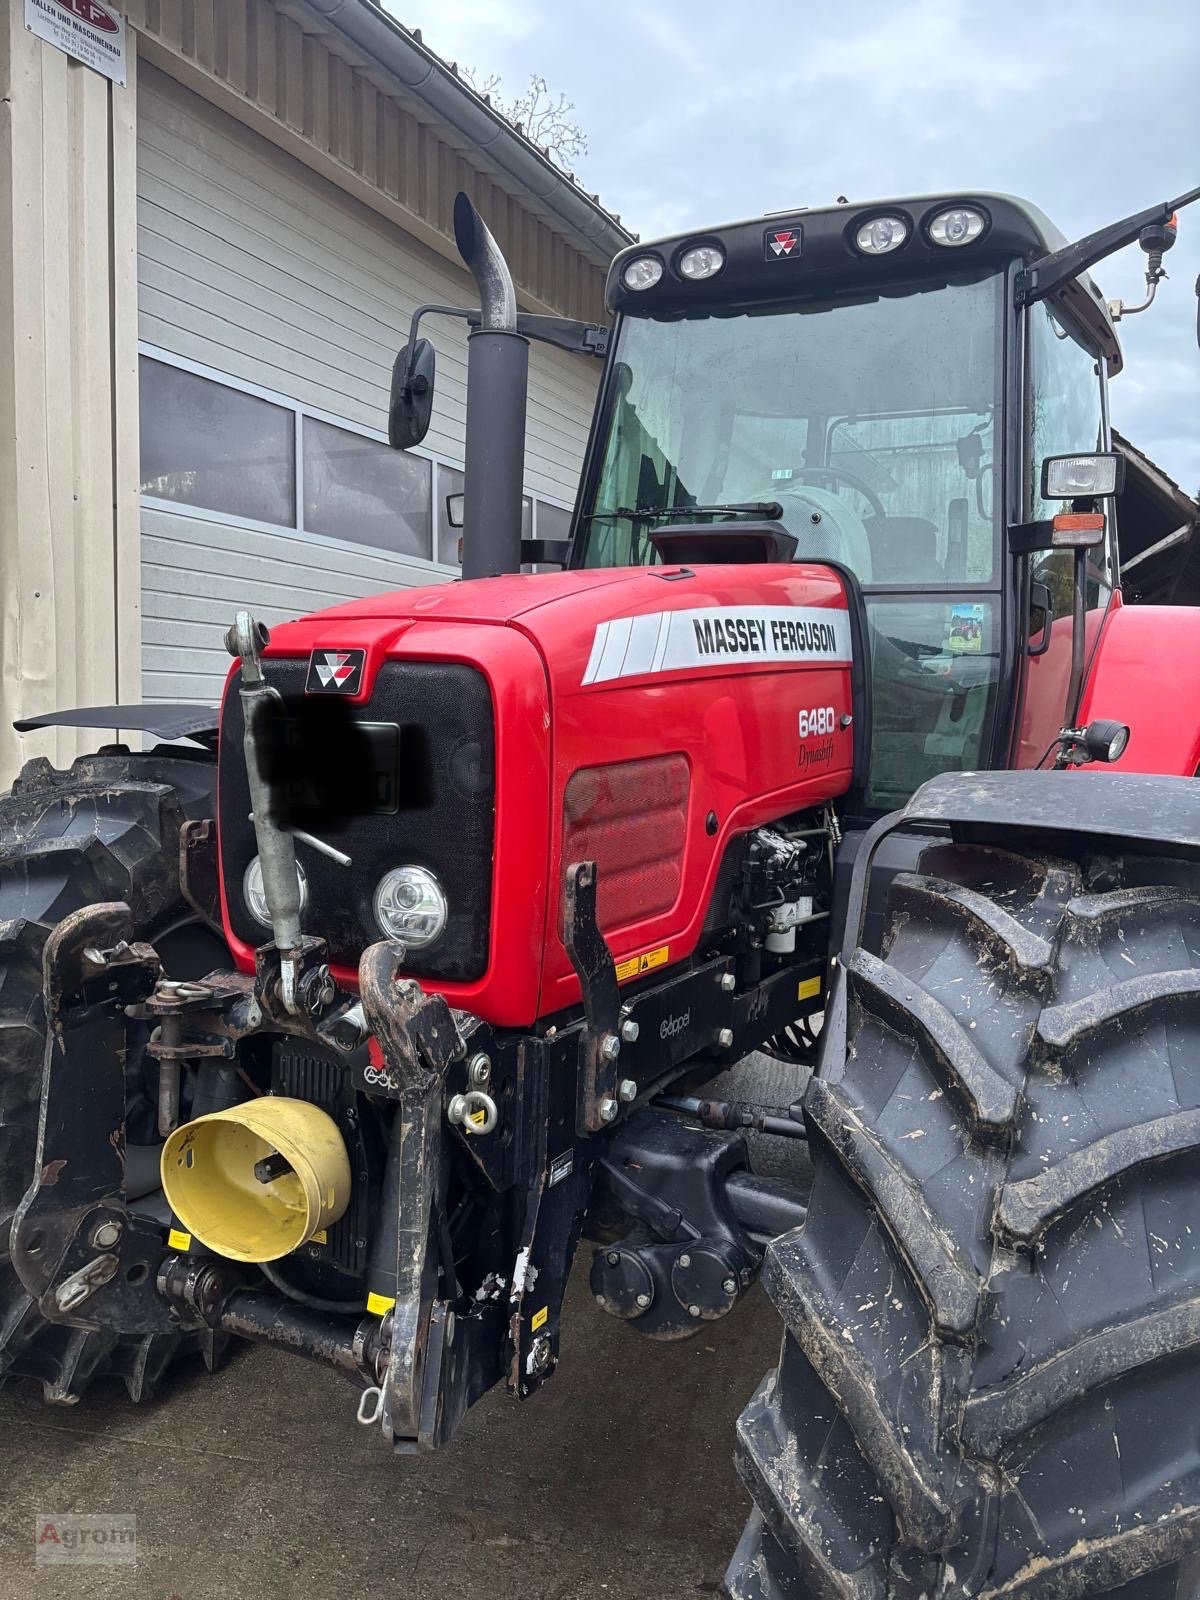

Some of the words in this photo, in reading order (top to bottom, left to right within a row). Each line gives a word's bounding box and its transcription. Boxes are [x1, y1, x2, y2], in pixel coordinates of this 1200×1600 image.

[57, 11, 71, 26] UND
[72, 21, 121, 57] MASCHINENBAU
[692, 618, 767, 654] MASSEY
[770, 620, 837, 653] FERGUSON
[799, 707, 835, 738] 6480
[798, 738, 834, 772] Dynashift
